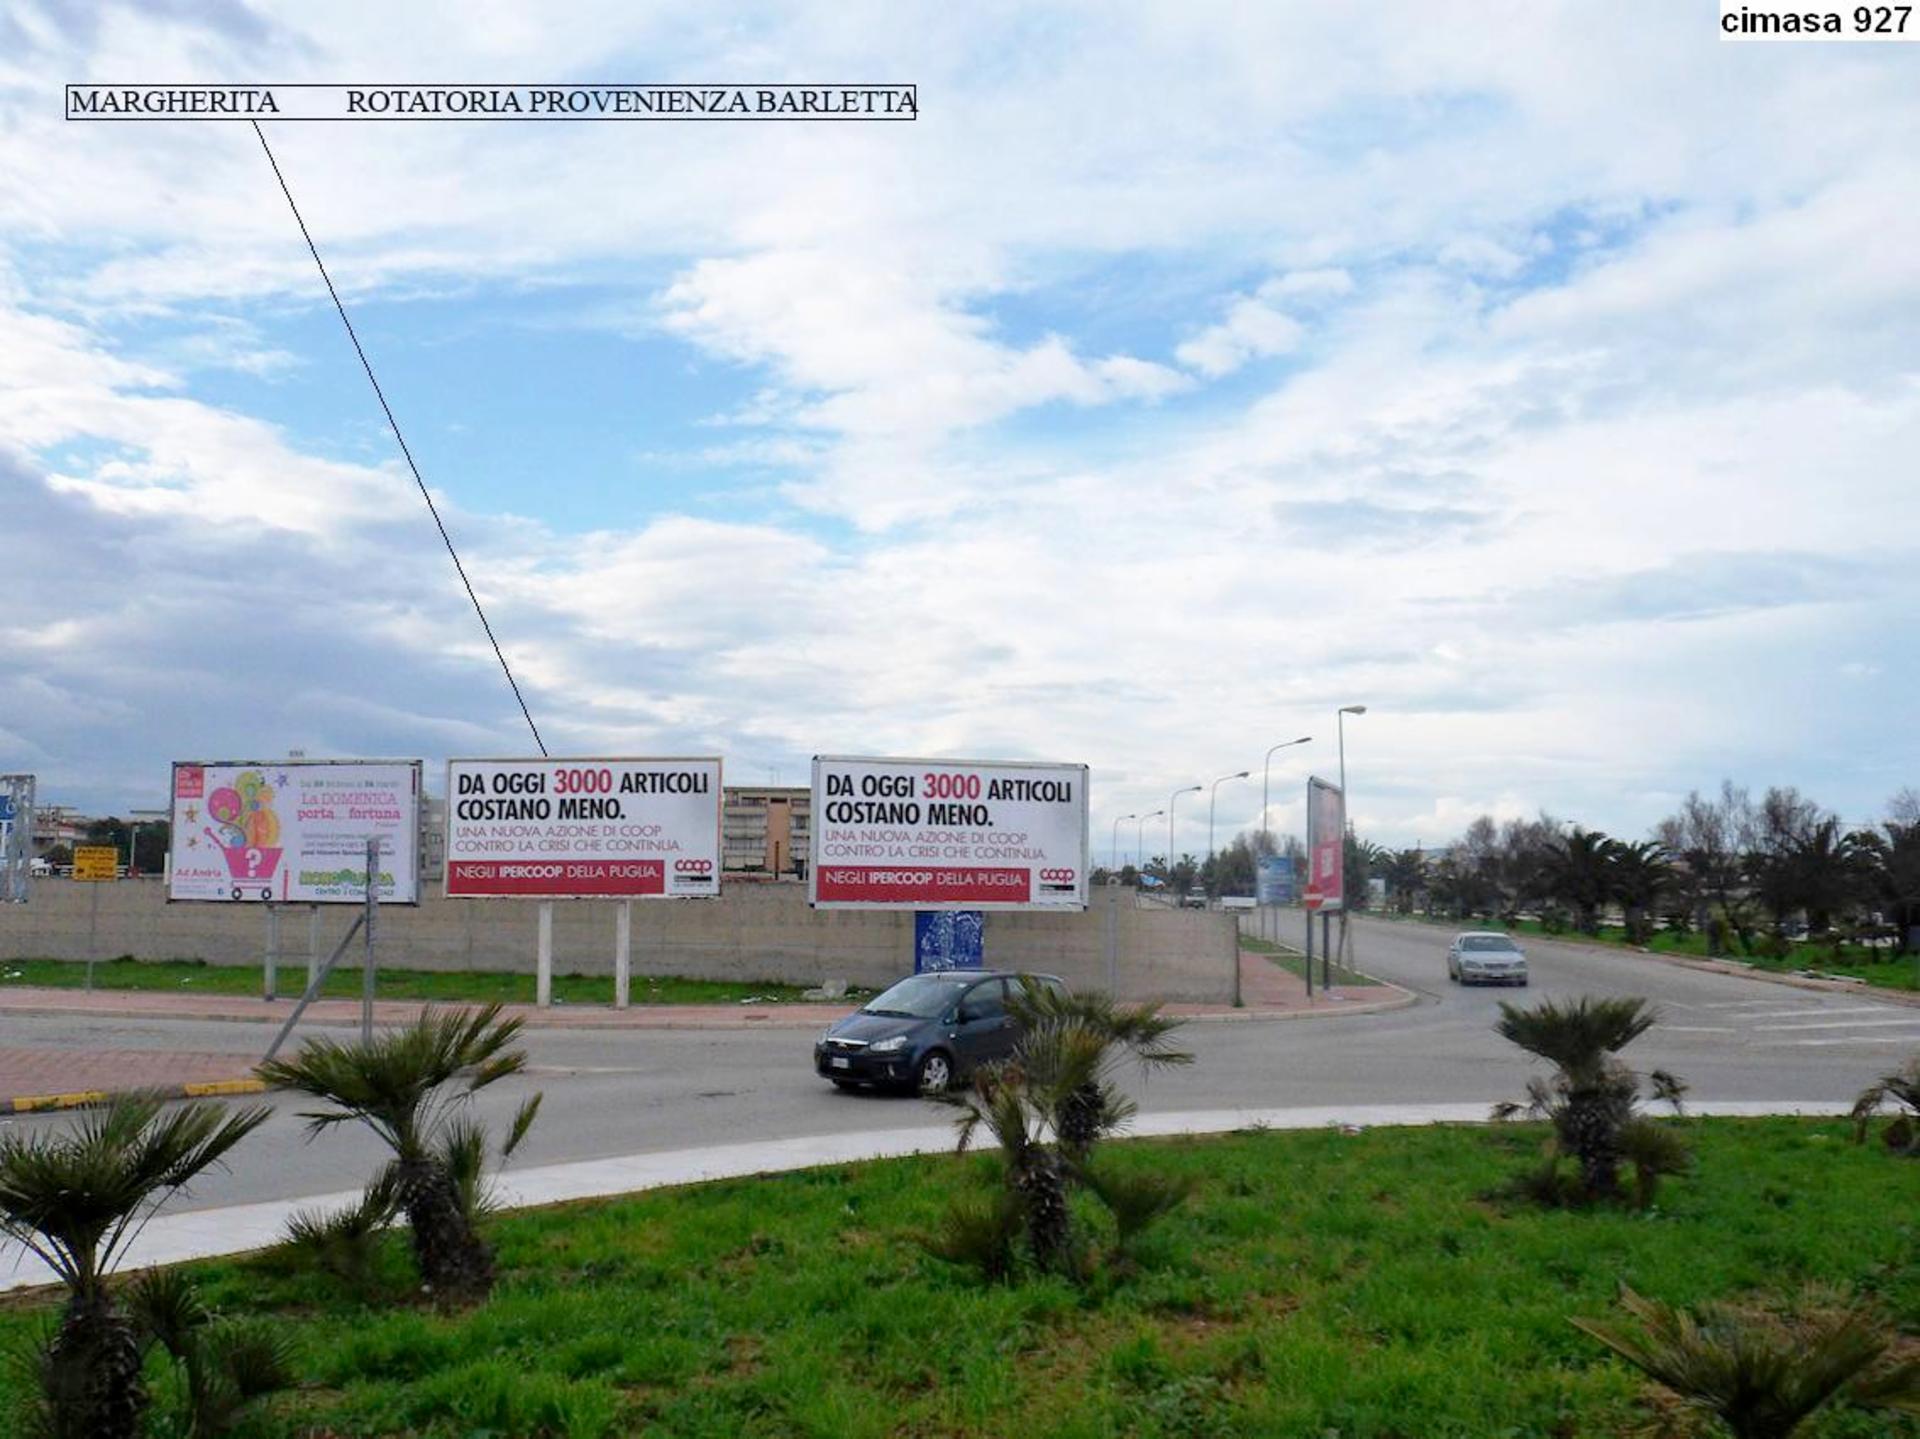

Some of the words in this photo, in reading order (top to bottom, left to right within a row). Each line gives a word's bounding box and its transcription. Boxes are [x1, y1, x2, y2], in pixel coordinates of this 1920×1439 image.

[459, 775, 484, 794] DA
[493, 773, 545, 794] OGGI
[554, 770, 612, 793] 3000
[620, 773, 708, 793] ARTICOLI
[827, 775, 854, 796] DA
[862, 776, 914, 797] OGGI
[923, 774, 981, 799] 3000
[988, 779, 1071, 802] ARTICOLI
[349, 808, 401, 820] fortuna
[458, 799, 550, 820] COSTANO
[558, 799, 625, 819] MENO.
[826, 802, 920, 825] COSTANO
[928, 804, 993, 826] MENO.
[456, 827, 486, 837] UNA
[491, 826, 541, 837] NUOVA
[546, 826, 597, 837] AZIONE
[603, 826, 616, 836] DI
[620, 825, 662, 836] COOP
[825, 831, 856, 842] UNA
[861, 831, 911, 842] NUOVA
[916, 832, 967, 843] AZIONE
[971, 833, 984, 843] DI
[988, 833, 1027, 844] COOP
[456, 841, 513, 852] CONTRO
[518, 840, 533, 852] LA
[538, 840, 570, 851] CRISI
[574, 840, 602, 851] CHE
[824, 845, 884, 857] CONTRO
[889, 846, 903, 857] LA
[908, 847, 939, 858] CRISI
[944, 847, 971, 859] CHE
[456, 866, 495, 878] NEGLI
[499, 866, 563, 878] IPERCOOP
[567, 866, 605, 878] DELLA
[825, 871, 865, 883] NEGLI
[870, 872, 933, 884] IPERCOOP
[937, 873, 974, 885] DELLA
